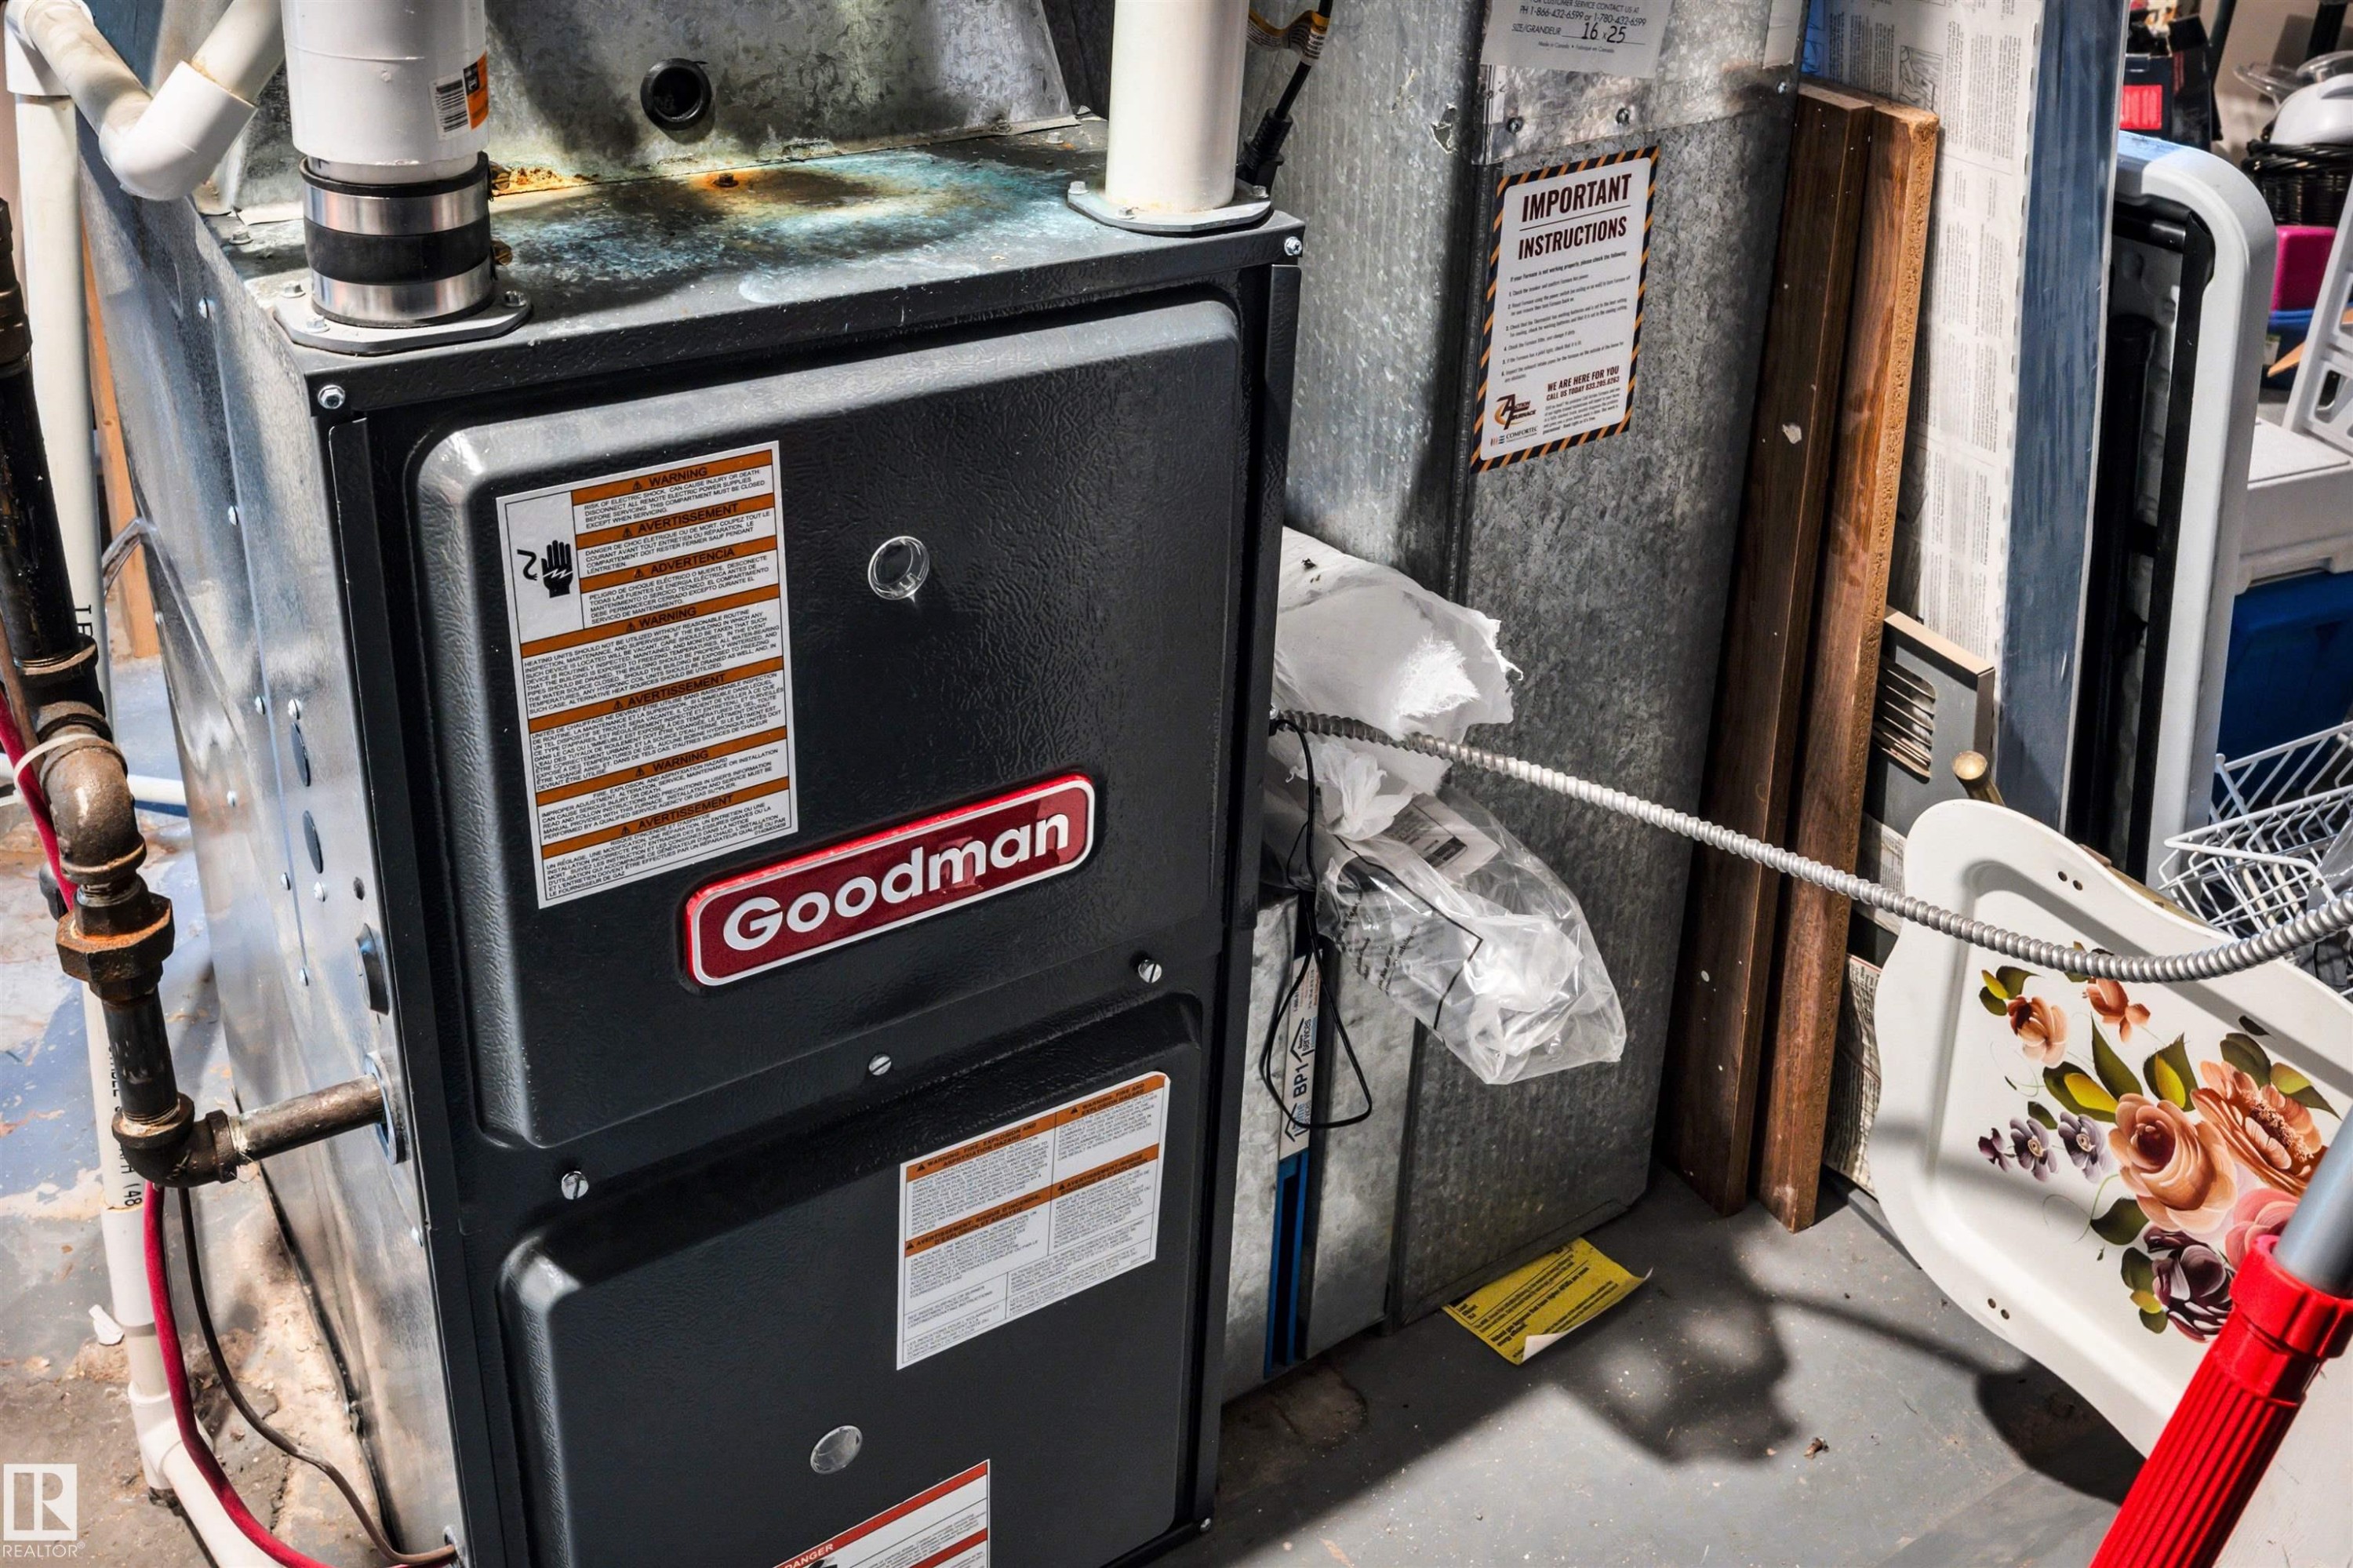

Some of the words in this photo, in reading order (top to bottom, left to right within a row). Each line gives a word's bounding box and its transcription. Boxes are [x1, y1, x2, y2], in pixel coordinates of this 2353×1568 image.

[1519, 5, 1528, 14] PH
[1530, 6, 1584, 20] 1-866-432-6599
[1594, 13, 1646, 27] 1-780-432-6599
[1596, 2, 1624, 12] CONTACT
[1511, 23, 1562, 35] SIZE/GRANDEUR
[1581, 22, 1598, 40] 16
[1606, 26, 1627, 43] 25
[1522, 173, 1631, 222] IMPORTANT
[1518, 216, 1627, 260] INSTRUCTIONS
[1547, 381, 1557, 391] WE
[1558, 377, 1572, 389] ARE
[1573, 373, 1591, 385] HERE
[1591, 369, 1605, 380] FOR
[1606, 365, 1620, 377] YOU
[1569, 385, 1584, 395] TODAY
[649, 466, 707, 486] WARNING
[584, 502, 599, 511] RISK
[610, 493, 641, 504] ELECTRIC
[683, 480, 704, 489] CAUSE
[706, 475, 727, 485] INJURY
[584, 503, 626, 517] DISCONNECT
[639, 494, 666, 505] REMOTE
[667, 488, 697, 500] ELECTRIC
[698, 482, 722, 493] POWER
[722, 476, 751, 488] SUPPLIES
[585, 512, 611, 523] BEFORE
[664, 491, 711, 506] COMPARTMENT
[713, 487, 730, 496] MUST
[740, 479, 765, 490] CLOSED
[586, 518, 611, 529] EXCEPT
[612, 514, 631, 523] WHEN
[637, 503, 738, 533] AVERTISSEMENT
[585, 544, 612, 556] DANGER
[624, 538, 642, 548] CHOC
[719, 515, 744, 526] COUPEZ
[745, 511, 761, 521] TOUT
[585, 551, 616, 562] COURANT
[617, 545, 638, 555] AVANT
[640, 541, 656, 551] TOUT
[658, 533, 692, 547] ENTRETIEN
[656, 542, 680, 553] RESTER
[682, 537, 707, 548] FERMER
[726, 526, 753, 537] PENDANT
[650, 547, 735, 574] ADVERTENCIA
[589, 589, 616, 600] PELIGRO
[627, 580, 654, 591] CHOQUE
[726, 555, 766, 569] DESCONECTE
[590, 597, 611, 606] TODAS
[625, 587, 653, 598] FUENTES
[727, 566, 747, 574] ANTES
[591, 613, 620, 624] SERVICIO
[638, 606, 696, 629] WARNING
[627, 673, 726, 707] AVERTISSEMENT
[653, 749, 708, 773] WARNING
[660, 763, 703, 780] ASPHYXIATION
[704, 756, 727, 767] HAZARD
[541, 805, 574, 819] IMPROPER
[686, 762, 727, 778] MAINTENANCE
[738, 748, 777, 763] INSTALLATION
[541, 816, 555, 824] CAN
[556, 809, 577, 820] CAUSE
[579, 802, 606, 813] SERIOUS
[607, 795, 628, 806] INJURY
[638, 795, 733, 830] AVERTISSEMENT
[723, 813, 1068, 951] Goodman
[1293, 1063, 1308, 1098] BP1
[943, 1146, 992, 1166] ASPHYXIATION
[994, 1134, 1021, 1148] HAZARD
[983, 1129, 1020, 1146] EXPLOSION
